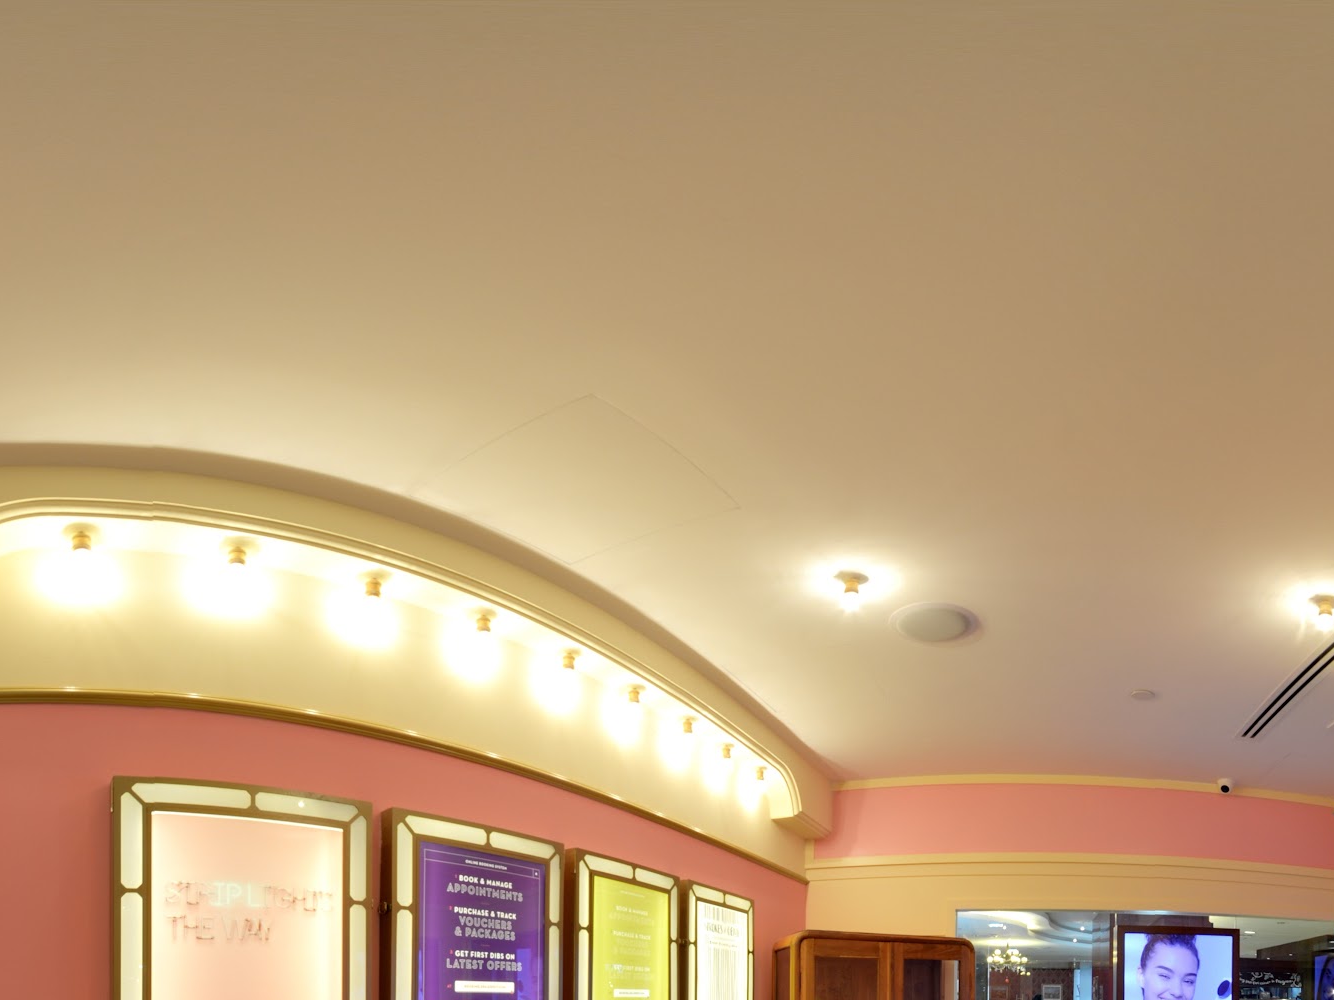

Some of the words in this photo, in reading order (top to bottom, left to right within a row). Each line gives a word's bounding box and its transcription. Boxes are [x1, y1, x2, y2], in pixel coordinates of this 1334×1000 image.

[458, 874, 479, 884] BOOK
[486, 878, 513, 889] MANAGE
[447, 882, 524, 902] APPOINTMENTS
[454, 906, 489, 917] PURCHASE
[497, 911, 517, 920] TRACK
[458, 915, 513, 930] VOUCHERS
[454, 926, 462, 937] &
[465, 927, 516, 941] PACKAGES
[455, 950, 468, 958] GET
[470, 951, 488, 959] FIRST
[490, 952, 504, 960] DIBS
[446, 958, 484, 970] LATEST
[486, 960, 522, 971] OFFERS
